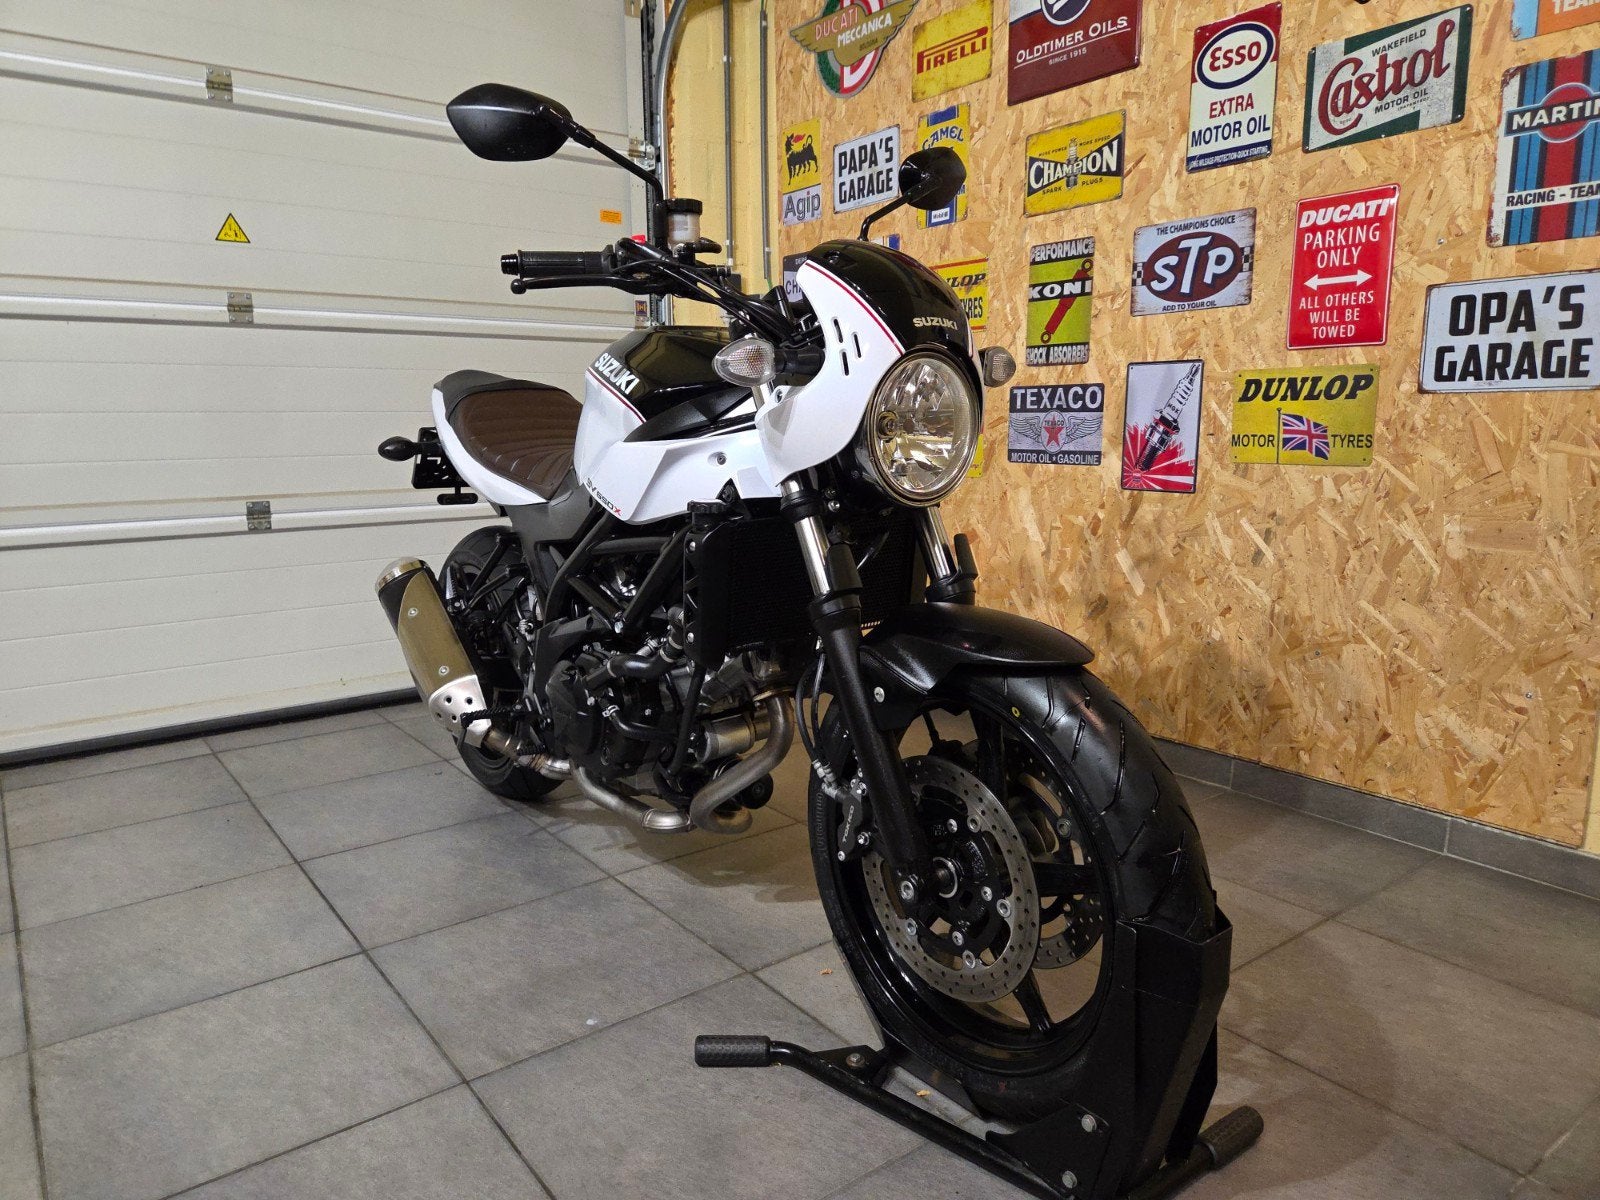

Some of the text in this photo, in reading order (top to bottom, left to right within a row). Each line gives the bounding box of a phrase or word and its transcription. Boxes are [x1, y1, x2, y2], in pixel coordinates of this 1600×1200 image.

[815, 7, 858, 40] DUCATI
[838, 12, 892, 47] MECCANICA
[917, 26, 988, 74] PIRELLI
[1016, 16, 1128, 63] OLDTIMER OILS
[1371, 28, 1426, 57] WAKEFIELD
[1049, 48, 1087, 65] SINCE 1915
[1318, 18, 1455, 135] Castrol
[1209, 93, 1254, 119] EXTRA
[1374, 88, 1429, 114] MOTOR OIL
[922, 126, 964, 151] CAMEL
[1191, 114, 1271, 148] MOTOR OIL
[838, 136, 893, 177] PAPA'S
[1029, 139, 1119, 189] CHAMPION
[838, 167, 893, 204] GARAGE
[1042, 186, 1062, 195] SPARK
[1506, 189, 1555, 207] RACING
[784, 191, 821, 221] Agip
[1300, 198, 1390, 228] DUCATI
[1156, 215, 1236, 236] THE CHAMPIONS CHOICE
[1304, 223, 1380, 250] PARKING
[1031, 237, 1095, 262] PERFORMANCE
[1317, 246, 1362, 269] ONLY
[1150, 235, 1235, 294] STP
[946, 273, 986, 288] LOP
[1029, 280, 1092, 299] KONI
[1162, 304, 1176, 312] ADD
[1187, 301, 1205, 309] YOUR
[1299, 290, 1374, 309] ALL OTHERS
[1449, 285, 1585, 336] OPA'S
[913, 316, 958, 331] SUZUKI
[1310, 308, 1360, 324] WILL BE
[1313, 325, 1355, 339] TOWED
[1026, 344, 1089, 365] SHOCK ABSORBERS
[1434, 338, 1593, 382] GARAGE
[594, 353, 640, 395] SUZUKI
[1013, 386, 1102, 409] TEXACO
[1238, 374, 1375, 403] DUNLOP
[1231, 433, 1373, 449] MOTOR TYRES
[1011, 453, 1099, 465] MOTOR OIL GASOLINE
